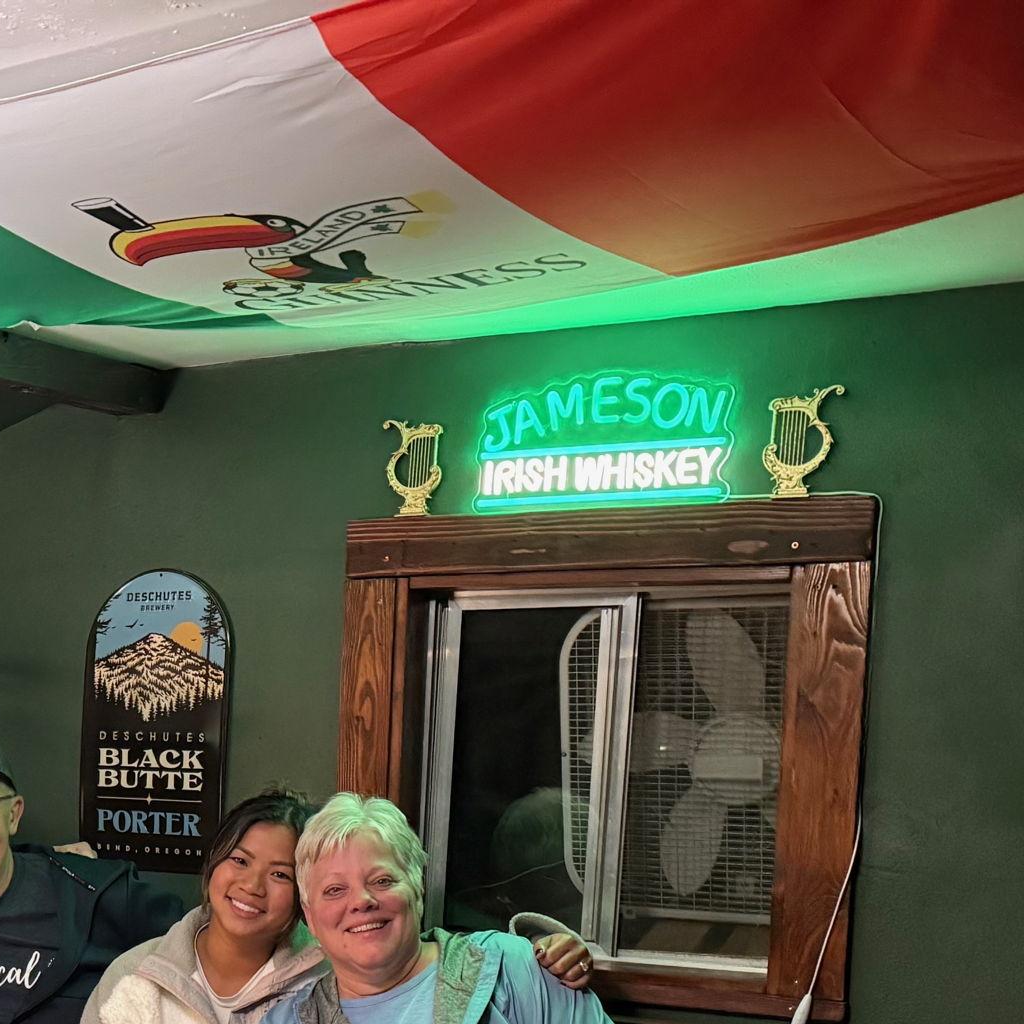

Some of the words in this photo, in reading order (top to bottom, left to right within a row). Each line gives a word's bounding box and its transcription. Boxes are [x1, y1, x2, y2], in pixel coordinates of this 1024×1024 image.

[257, 210, 367, 257] IRELAND
[234, 252, 587, 311] GUINNESS
[484, 376, 727, 452] JAMESON
[481, 455, 568, 496] IRISH
[575, 446, 722, 491] WHISKEY
[126, 590, 193, 602] DESCHUTES
[140, 604, 175, 612] BREWERY
[99, 730, 205, 743] DESCHUTES
[98, 747, 205, 770] BLACK
[97, 769, 204, 793] BUTTE
[96, 808, 202, 837] PORTER
[144, 846, 202, 857] OREGON
